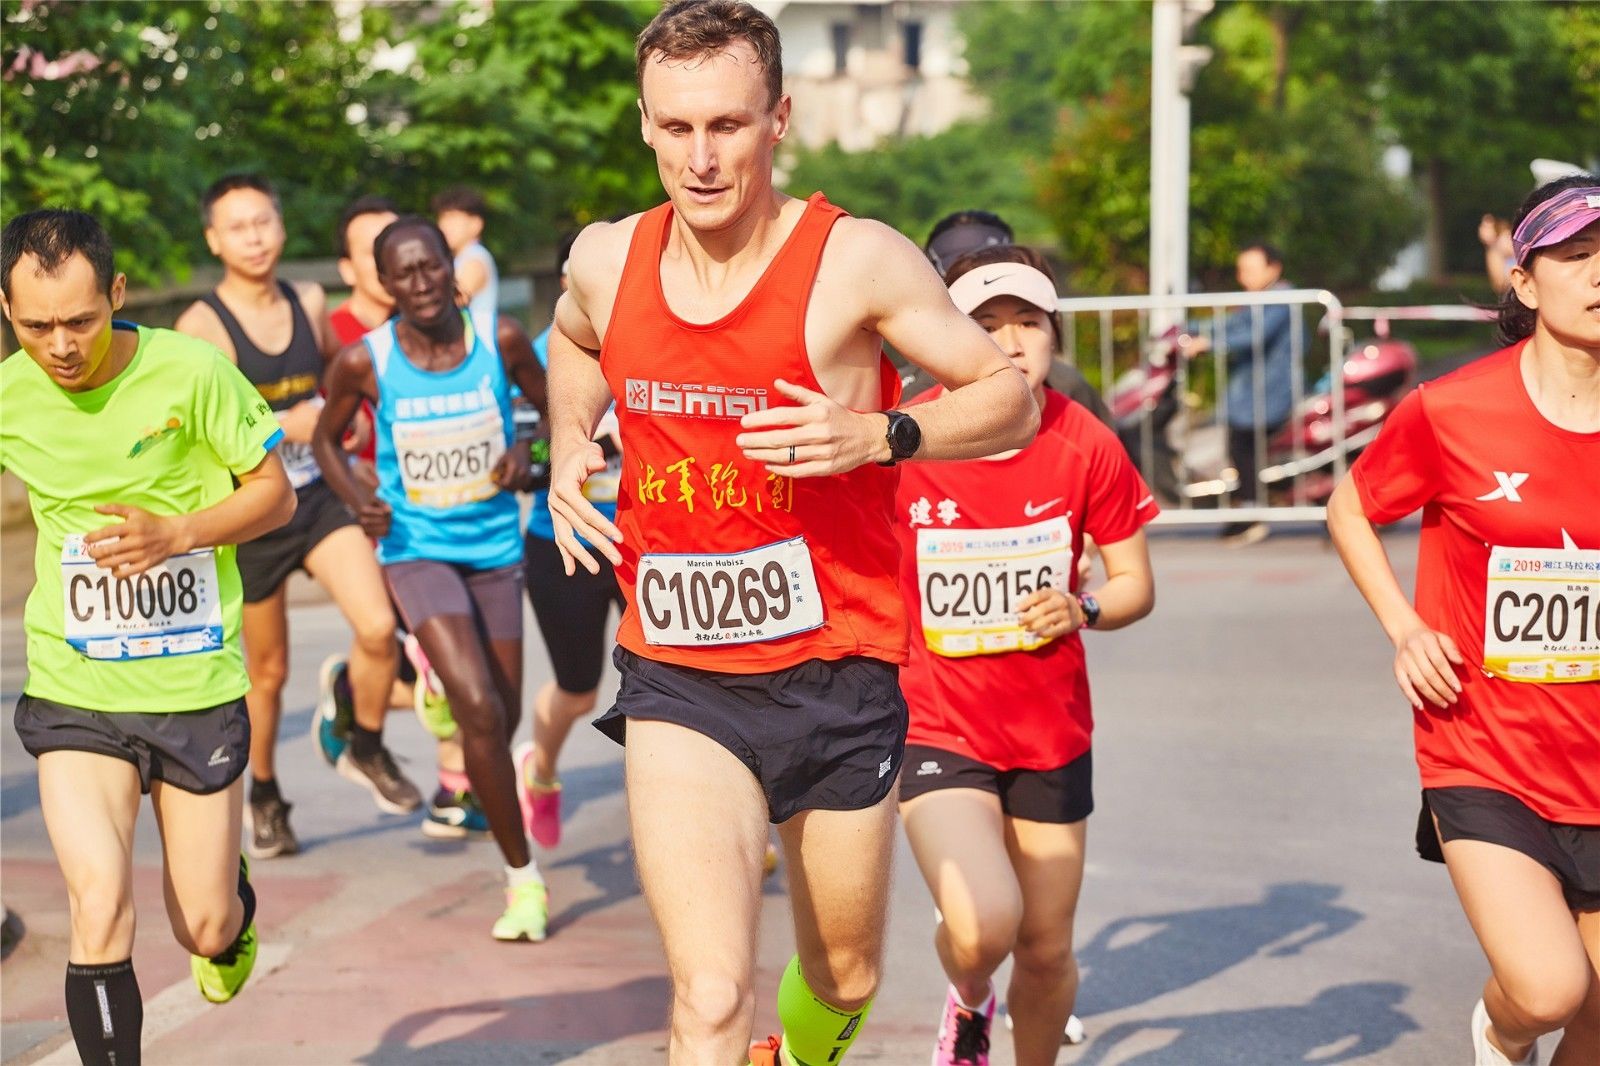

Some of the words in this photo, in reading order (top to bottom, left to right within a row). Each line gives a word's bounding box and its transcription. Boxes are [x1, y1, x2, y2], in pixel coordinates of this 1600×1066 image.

[662, 382, 703, 391] EVER
[706, 386, 767, 395] BEYOND
[404, 441, 491, 481] C20267
[686, 560, 713, 568] Marcin
[715, 558, 744, 567] Hubisz
[1513, 559, 1541, 572] 2019
[69, 567, 198, 622] C10008
[642, 560, 791, 631] C10269
[1493, 590, 1600, 642] C201
